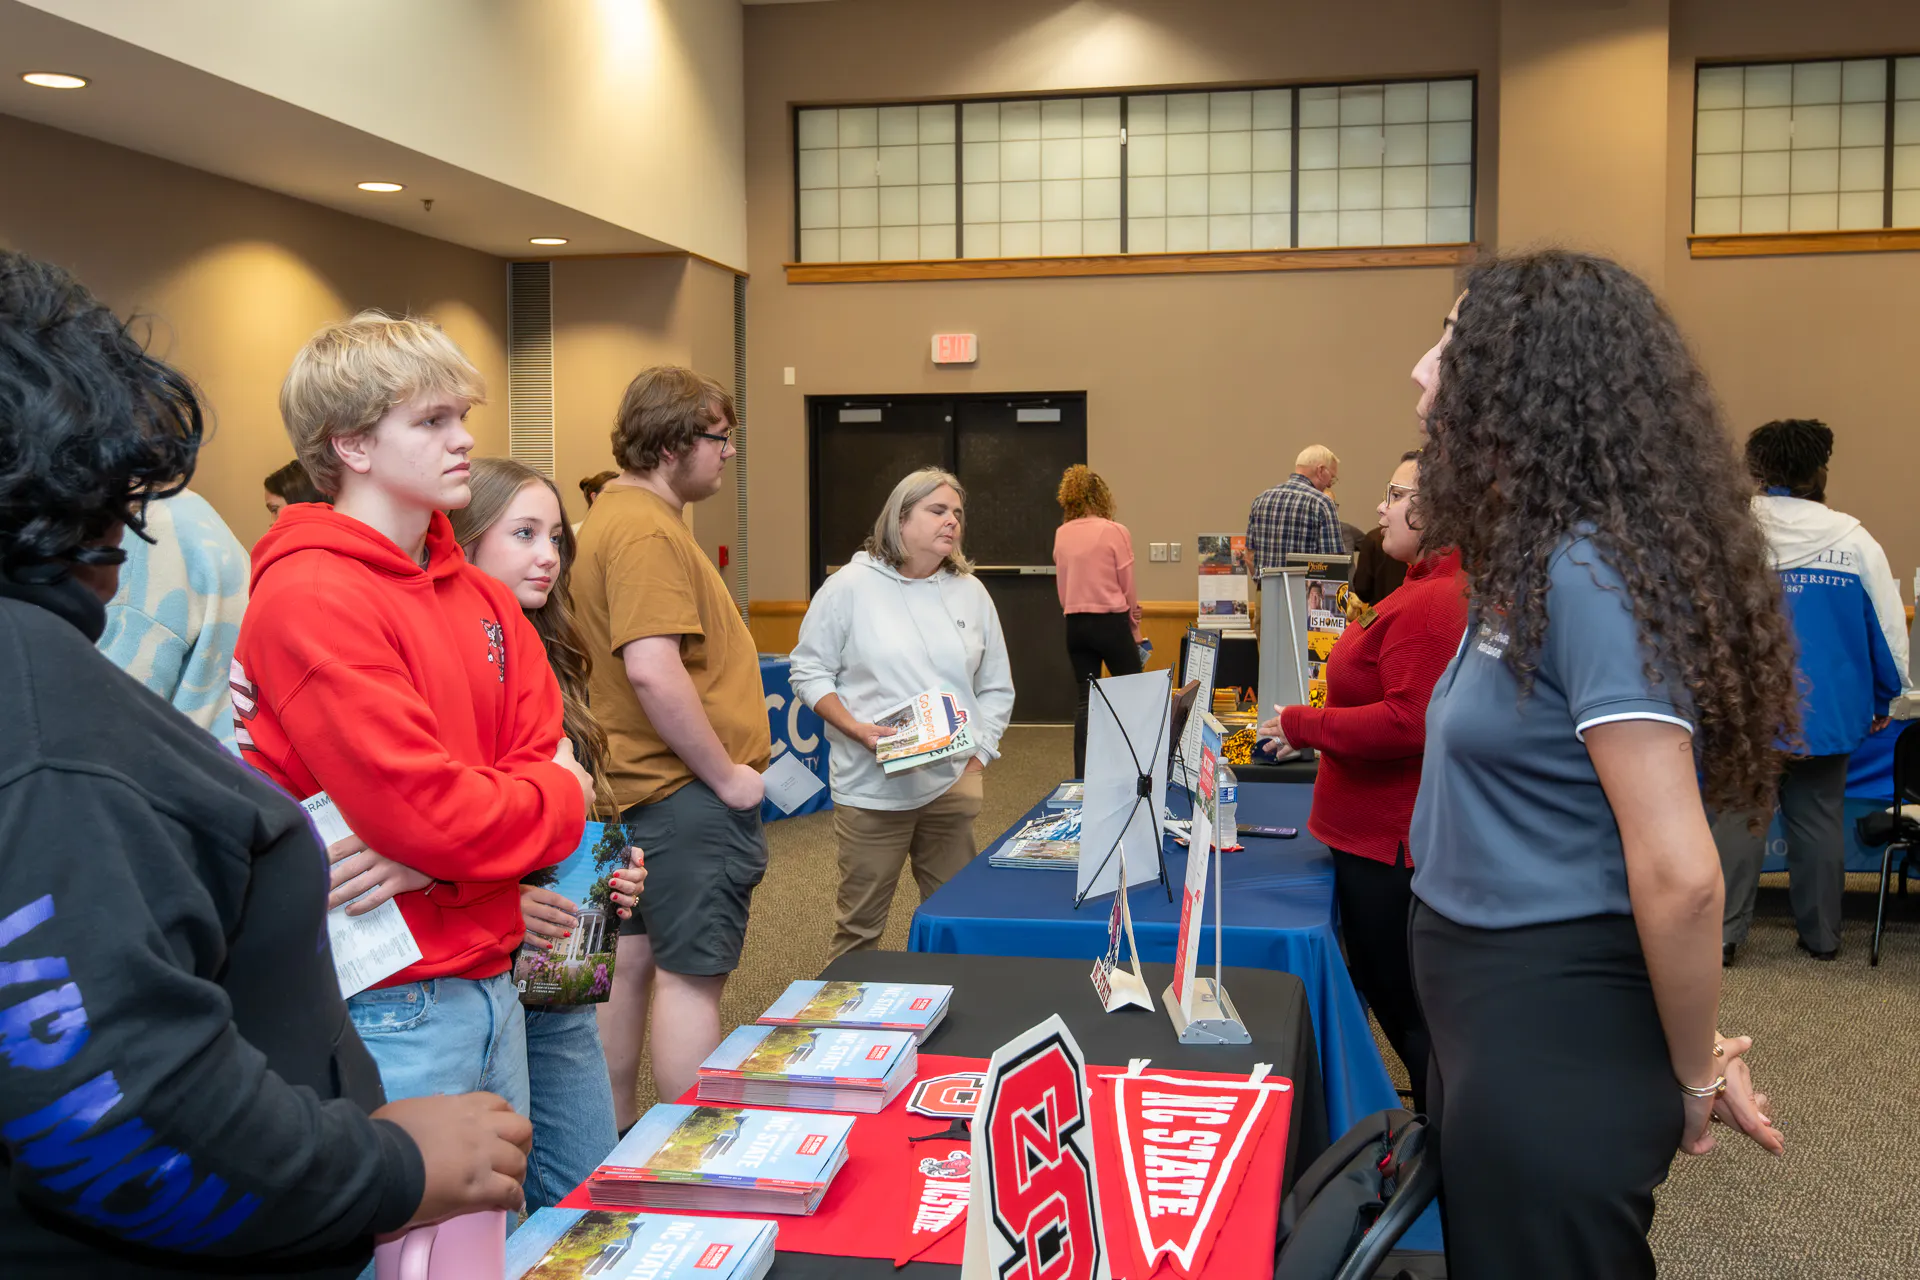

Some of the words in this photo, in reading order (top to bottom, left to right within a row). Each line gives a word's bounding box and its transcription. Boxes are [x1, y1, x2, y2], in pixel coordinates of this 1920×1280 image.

[938, 336, 971, 362] EXIT
[1311, 617, 1319, 627] IS
[1319, 617, 1344, 628] HOME
[919, 693, 929, 709] Go
[835, 1032, 860, 1045] NC
[815, 1044, 850, 1072] STATE
[1141, 1090, 1239, 1125] NC
[763, 1115, 795, 1132] NC
[736, 1132, 779, 1169] STATE
[1142, 1128, 1222, 1219] STATE
[659, 1221, 697, 1241] NC
[624, 1242, 677, 1280] STAT
